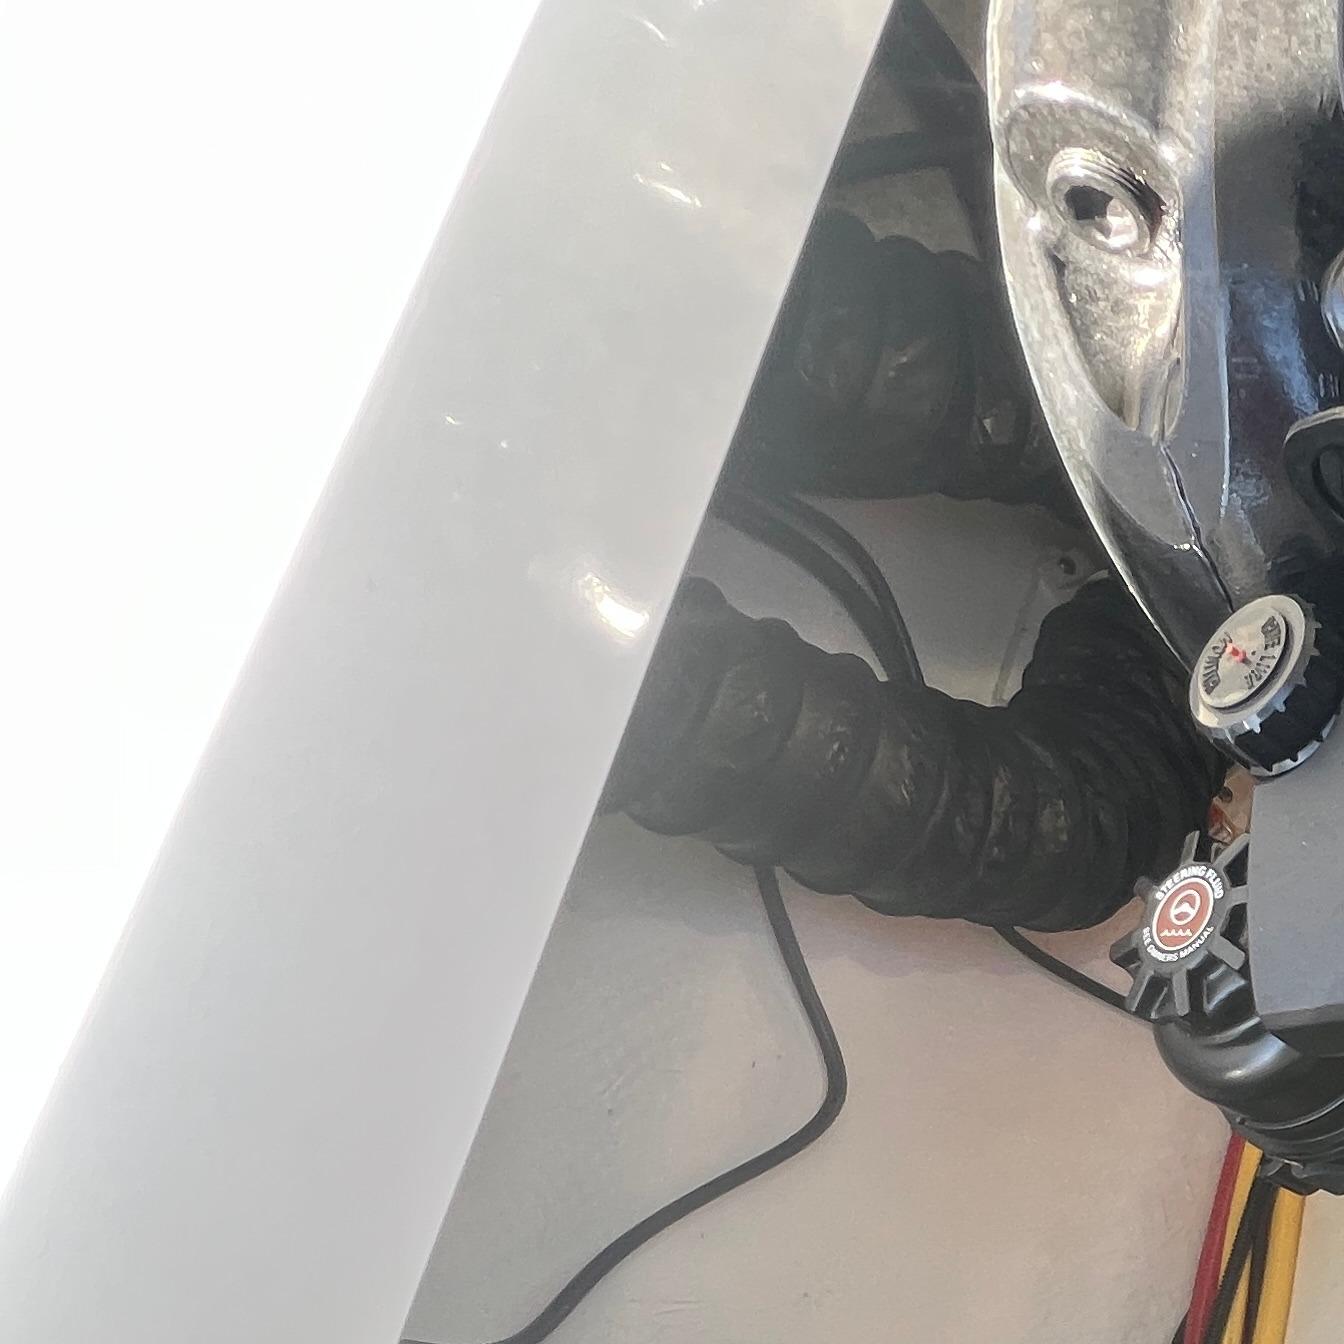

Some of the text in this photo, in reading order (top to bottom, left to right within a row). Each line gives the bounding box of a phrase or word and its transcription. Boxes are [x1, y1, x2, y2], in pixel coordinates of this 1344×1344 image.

[1155, 865, 1224, 900] STEERING FLUID
[1180, 926, 1214, 958] MANUAL
